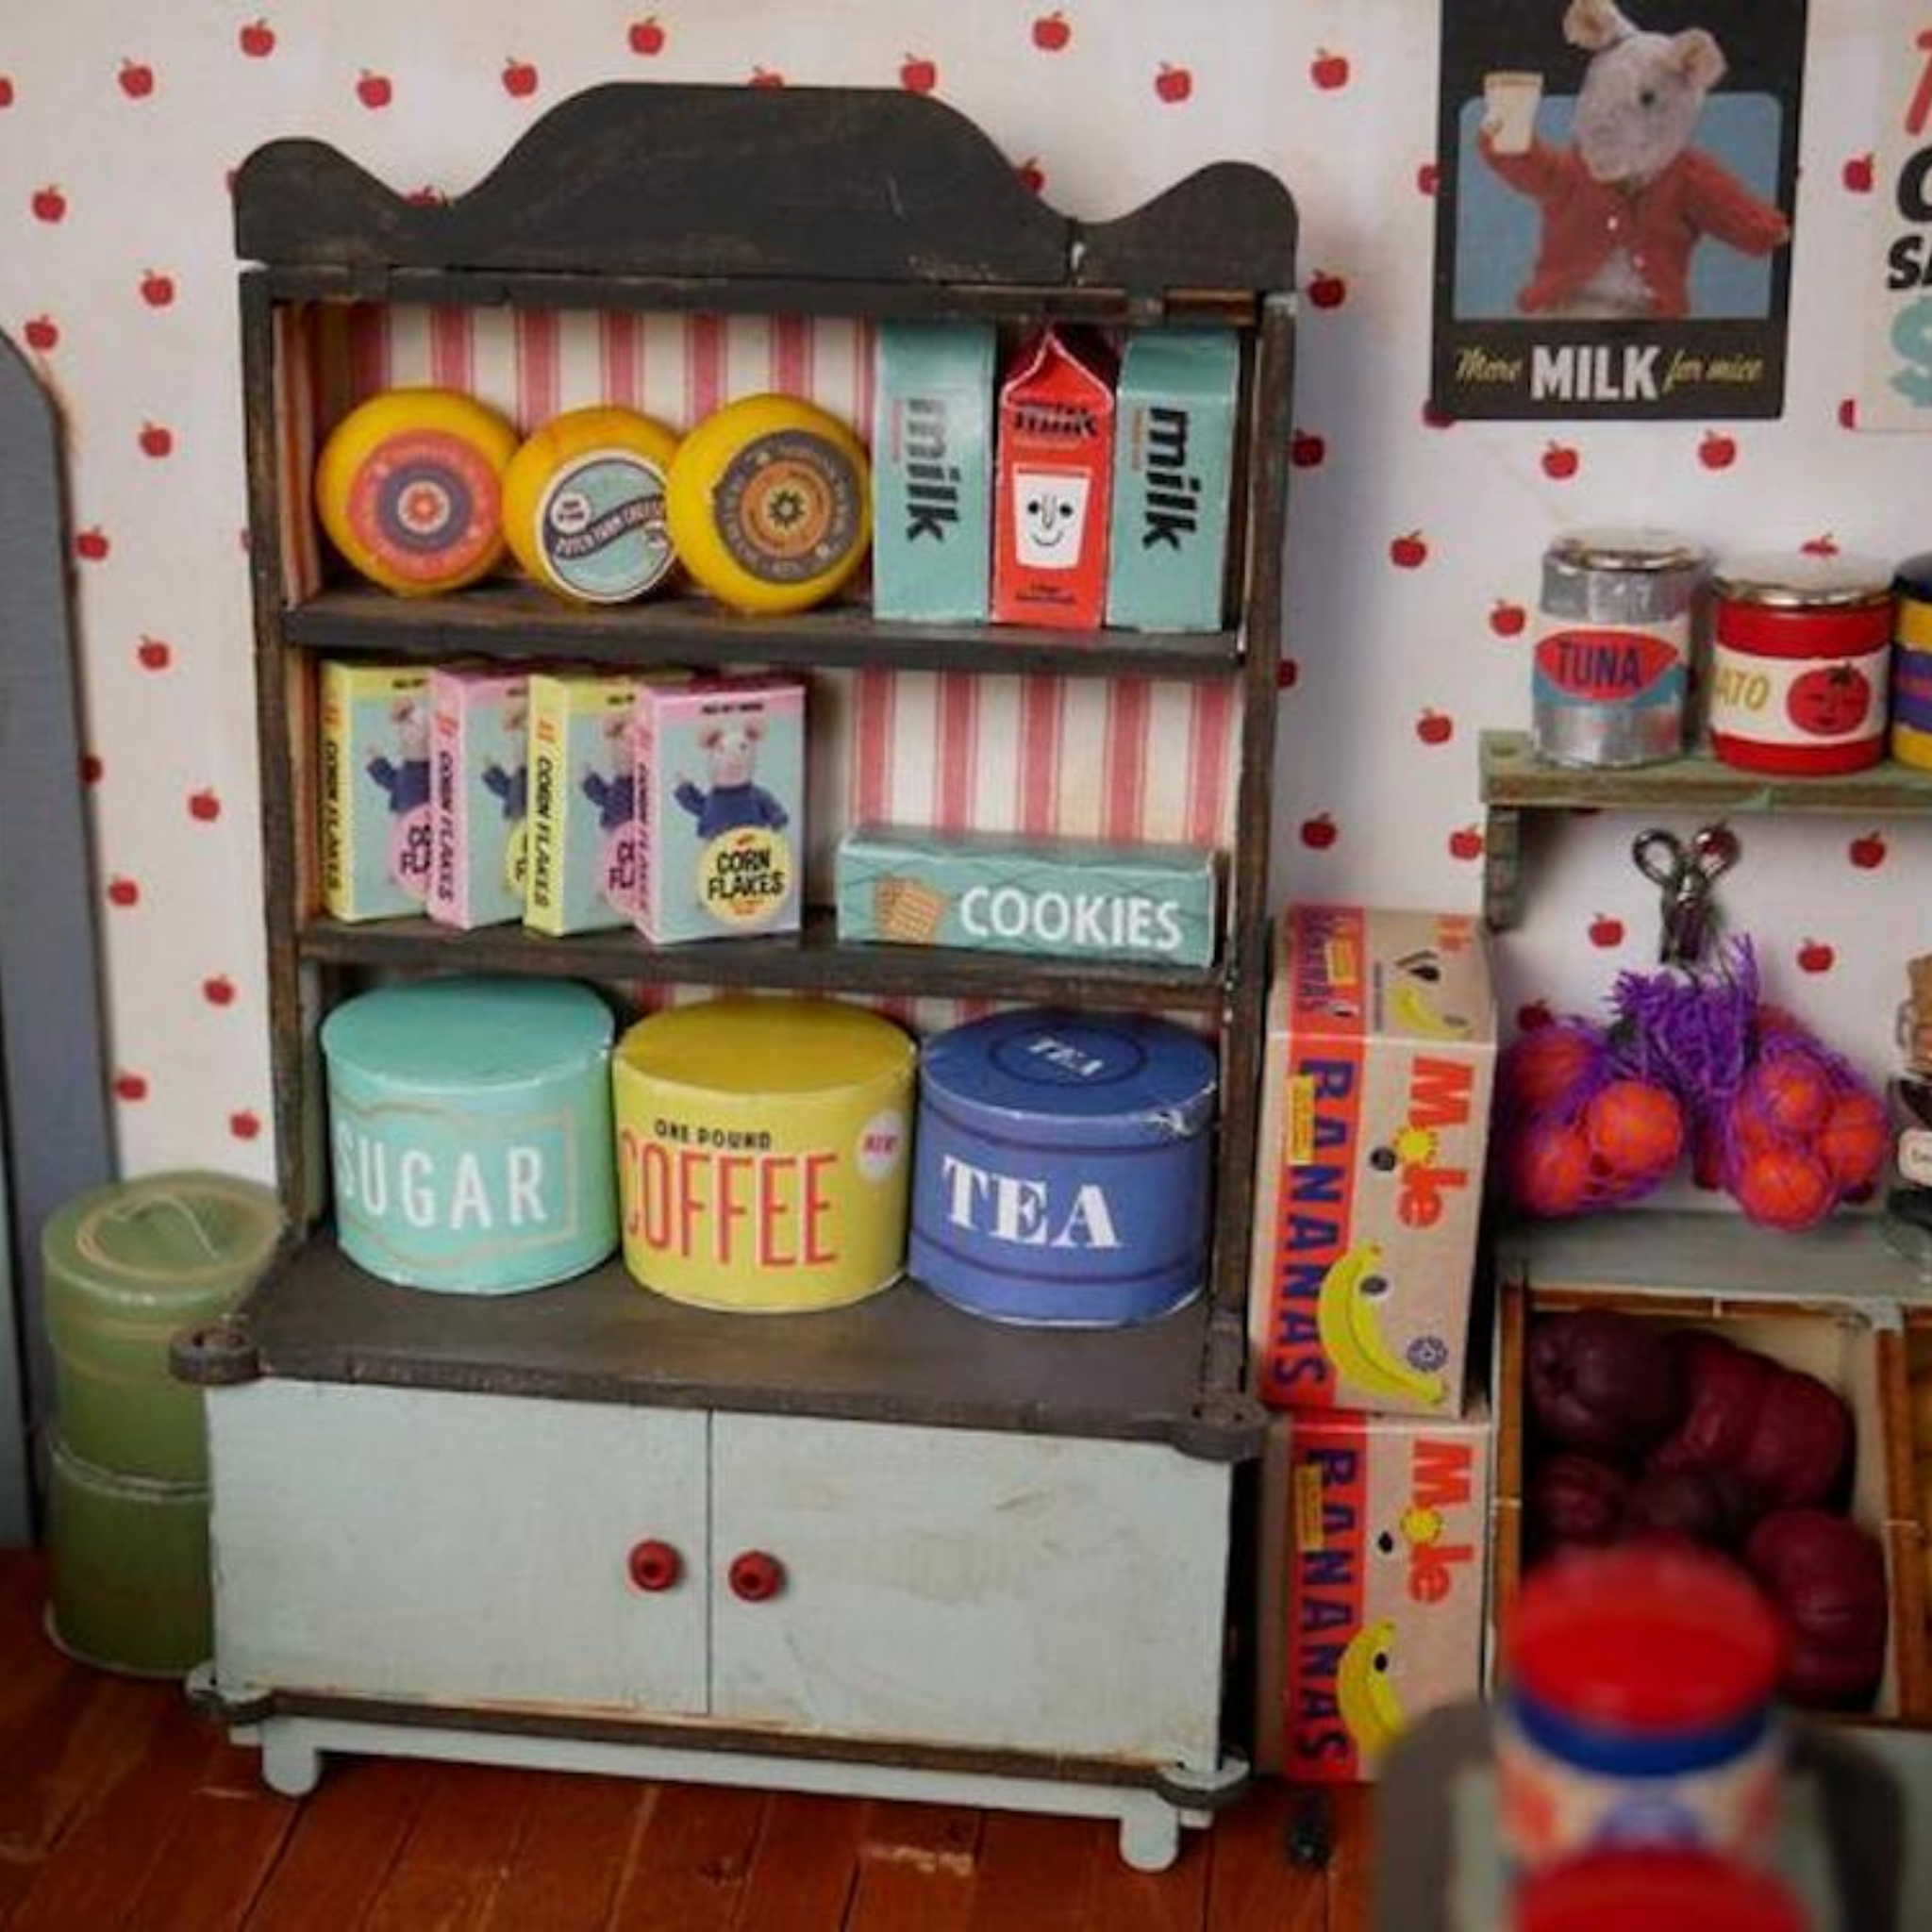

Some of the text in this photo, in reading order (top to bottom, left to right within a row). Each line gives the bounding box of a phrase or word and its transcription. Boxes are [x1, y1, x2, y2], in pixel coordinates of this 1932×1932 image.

[1530, 345, 1661, 401] MILK
[907, 398, 961, 541] milk
[1141, 407, 1202, 550] milk
[1557, 640, 1644, 689] TUNA
[536, 756, 552, 816] CORN
[534, 821, 551, 908] FLAKES
[708, 870, 786, 901] FLAKES
[716, 848, 772, 875] CORN
[960, 887, 1183, 950] COOKIES
[1028, 1038, 1104, 1076] TEA
[654, 1118, 772, 1150] ONE POUND
[335, 1120, 548, 1230] SUGAR
[619, 1128, 839, 1267] COFFEE
[941, 1153, 1124, 1249] TEA
